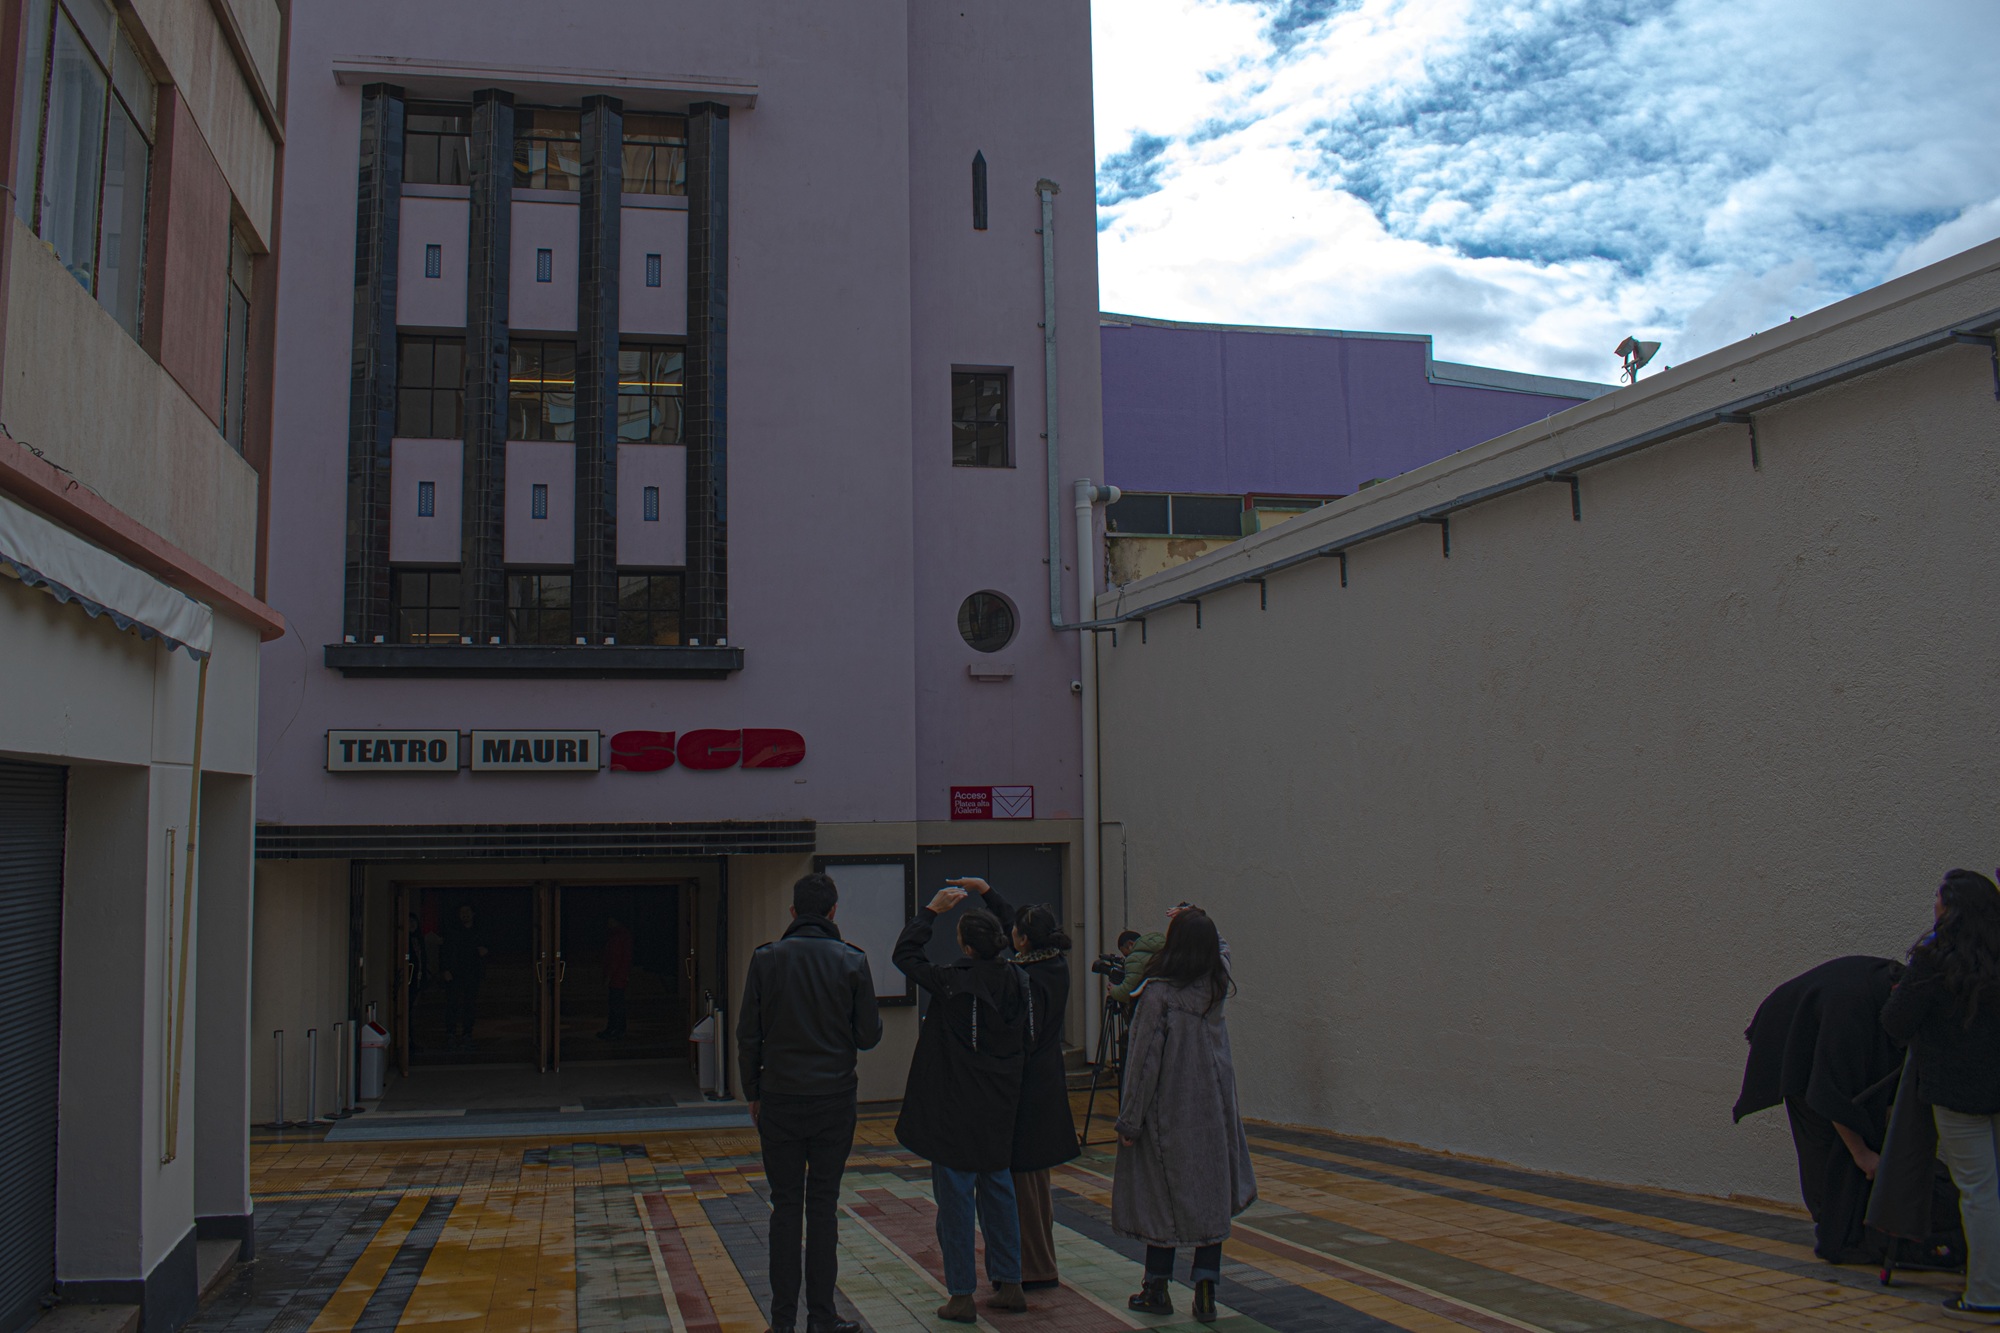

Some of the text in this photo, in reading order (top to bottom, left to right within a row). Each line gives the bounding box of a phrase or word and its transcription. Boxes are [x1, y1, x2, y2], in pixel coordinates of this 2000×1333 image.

[339, 739, 589, 763] TEATRO MAURI
[610, 728, 805, 772] SCD
[954, 791, 987, 800] Acceso
[954, 799, 990, 808] Platea alta
